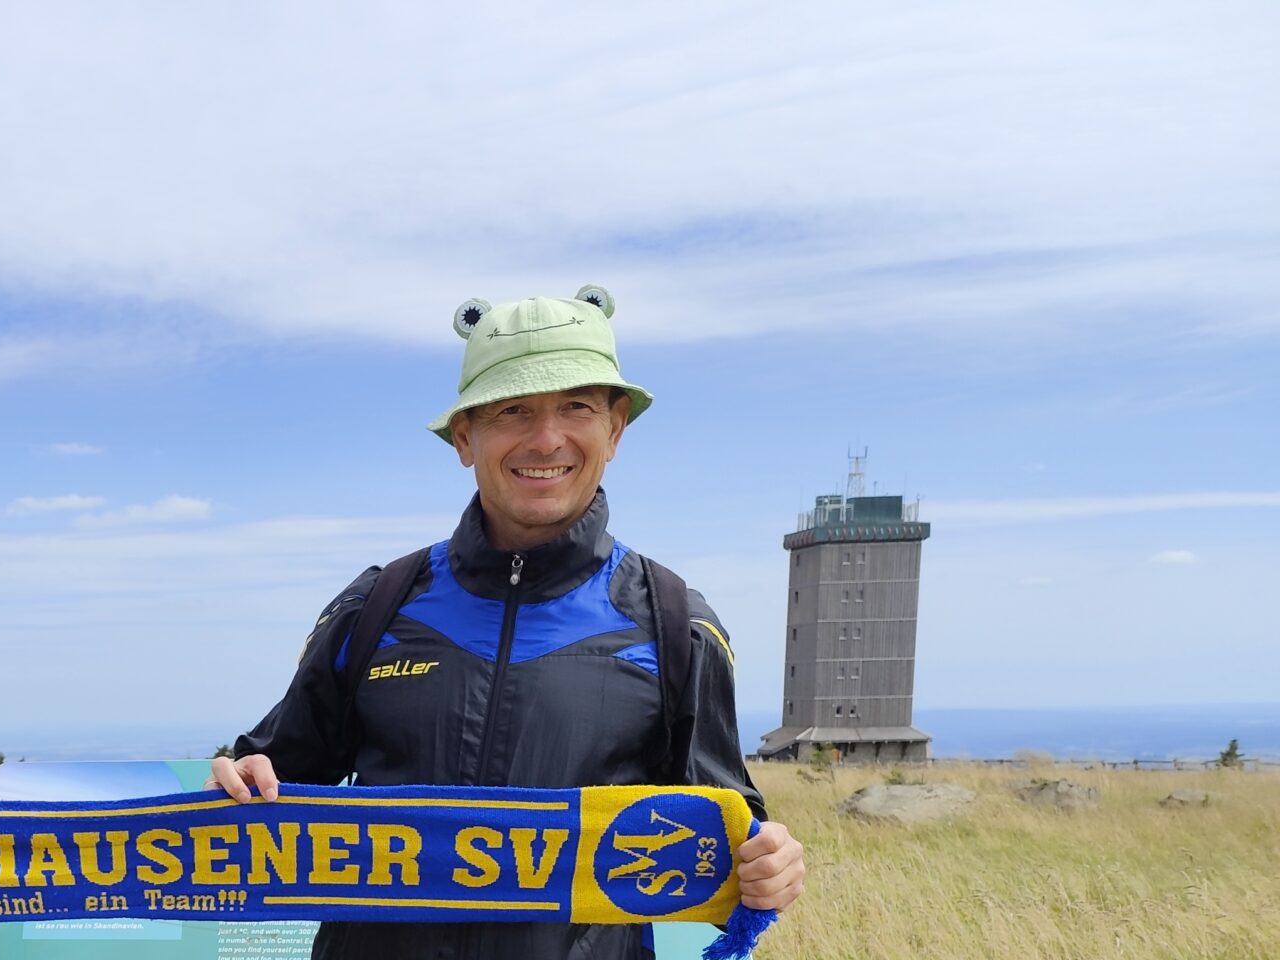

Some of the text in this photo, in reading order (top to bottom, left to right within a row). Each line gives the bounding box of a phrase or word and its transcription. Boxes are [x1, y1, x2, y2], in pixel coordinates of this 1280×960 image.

[368, 660, 439, 680] saller
[452, 826, 569, 889] SV
[694, 836, 718, 878] 1953
[85, 891, 128, 913] ein
[144, 889, 247, 912] Team!!!
